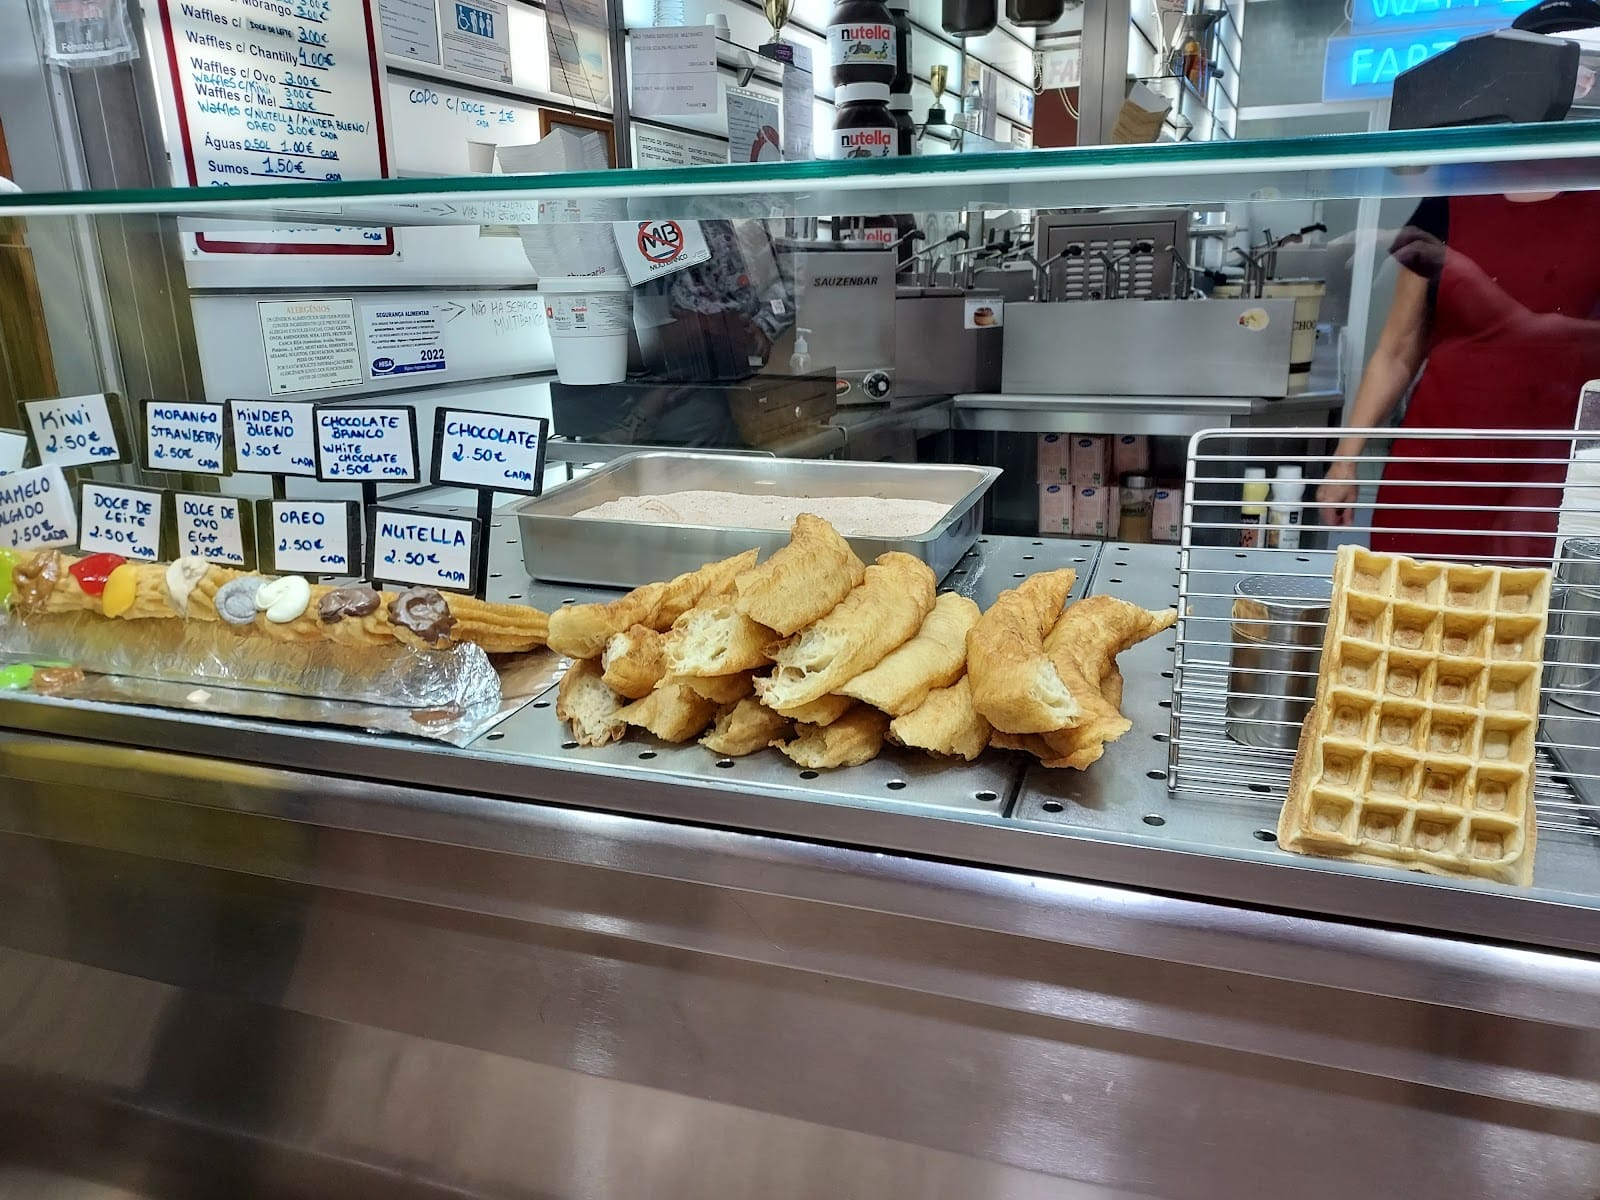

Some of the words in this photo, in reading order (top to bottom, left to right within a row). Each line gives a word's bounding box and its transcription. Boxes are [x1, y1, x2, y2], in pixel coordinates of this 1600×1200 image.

[181, 3, 228, 25] Waffles
[298, 26, 329, 43] 3.00€
[841, 25, 890, 40] nutella
[185, 30, 232, 51] Waffles
[250, 44, 298, 67] Chantilly
[299, 47, 336, 66] 4.00€
[1351, 41, 1456, 85] FAR
[190, 56, 237, 77] Waffles
[253, 69, 276, 84] Ovo
[285, 71, 320, 87] 3.00€
[194, 83, 240, 101] Waffles
[257, 97, 277, 107] Mel
[285, 87, 314, 99] 3.00€
[409, 89, 439, 106] COPO
[197, 101, 240, 116] Waffles
[247, 121, 277, 132] OREO
[287, 124, 317, 136] 3.00€
[205, 132, 242, 152] Águas
[280, 141, 315, 154] 1.00€
[841, 130, 891, 146] nutella
[208, 160, 249, 175] Sumos
[262, 156, 306, 174] 1.50€
[813, 276, 878, 287] SAUZENBAR
[420, 349, 445, 361] 2022
[154, 408, 217, 423] MORANGO
[321, 415, 400, 429] CHOCOLATE
[246, 422, 294, 438] BUENO
[331, 427, 384, 439] BRANCO
[446, 421, 537, 449] CHOCOLATE
[46, 431, 101, 453] 2.50€
[241, 442, 282, 457] 2.50€
[90, 446, 117, 456] CADA
[154, 444, 194, 459] 2.50€
[338, 453, 398, 463] CHOCOLATE
[451, 443, 507, 463] 2.50€
[197, 458, 219, 470] CADA
[291, 457, 314, 468] CADA
[329, 462, 373, 475] 2.50€
[382, 466, 408, 476] CADA
[504, 468, 532, 482] CADA
[93, 492, 129, 510] DOCE
[136, 500, 152, 515] DE
[184, 501, 215, 517] DOCE
[220, 506, 235, 519] DE
[193, 518, 218, 531] OVO
[279, 511, 325, 525] OREO
[12, 520, 54, 546] 2.50€
[42, 529, 69, 542] CADA
[89, 525, 138, 543] 2.50€
[188, 530, 218, 543] EGG
[381, 523, 466, 547] NUTELLA
[132, 546, 156, 557] CADA
[190, 545, 226, 557] 2.50€
[278, 538, 325, 551] 2.50€
[320, 554, 346, 565] CADA
[384, 550, 441, 565] 2.50€
[437, 569, 466, 582] CADA
